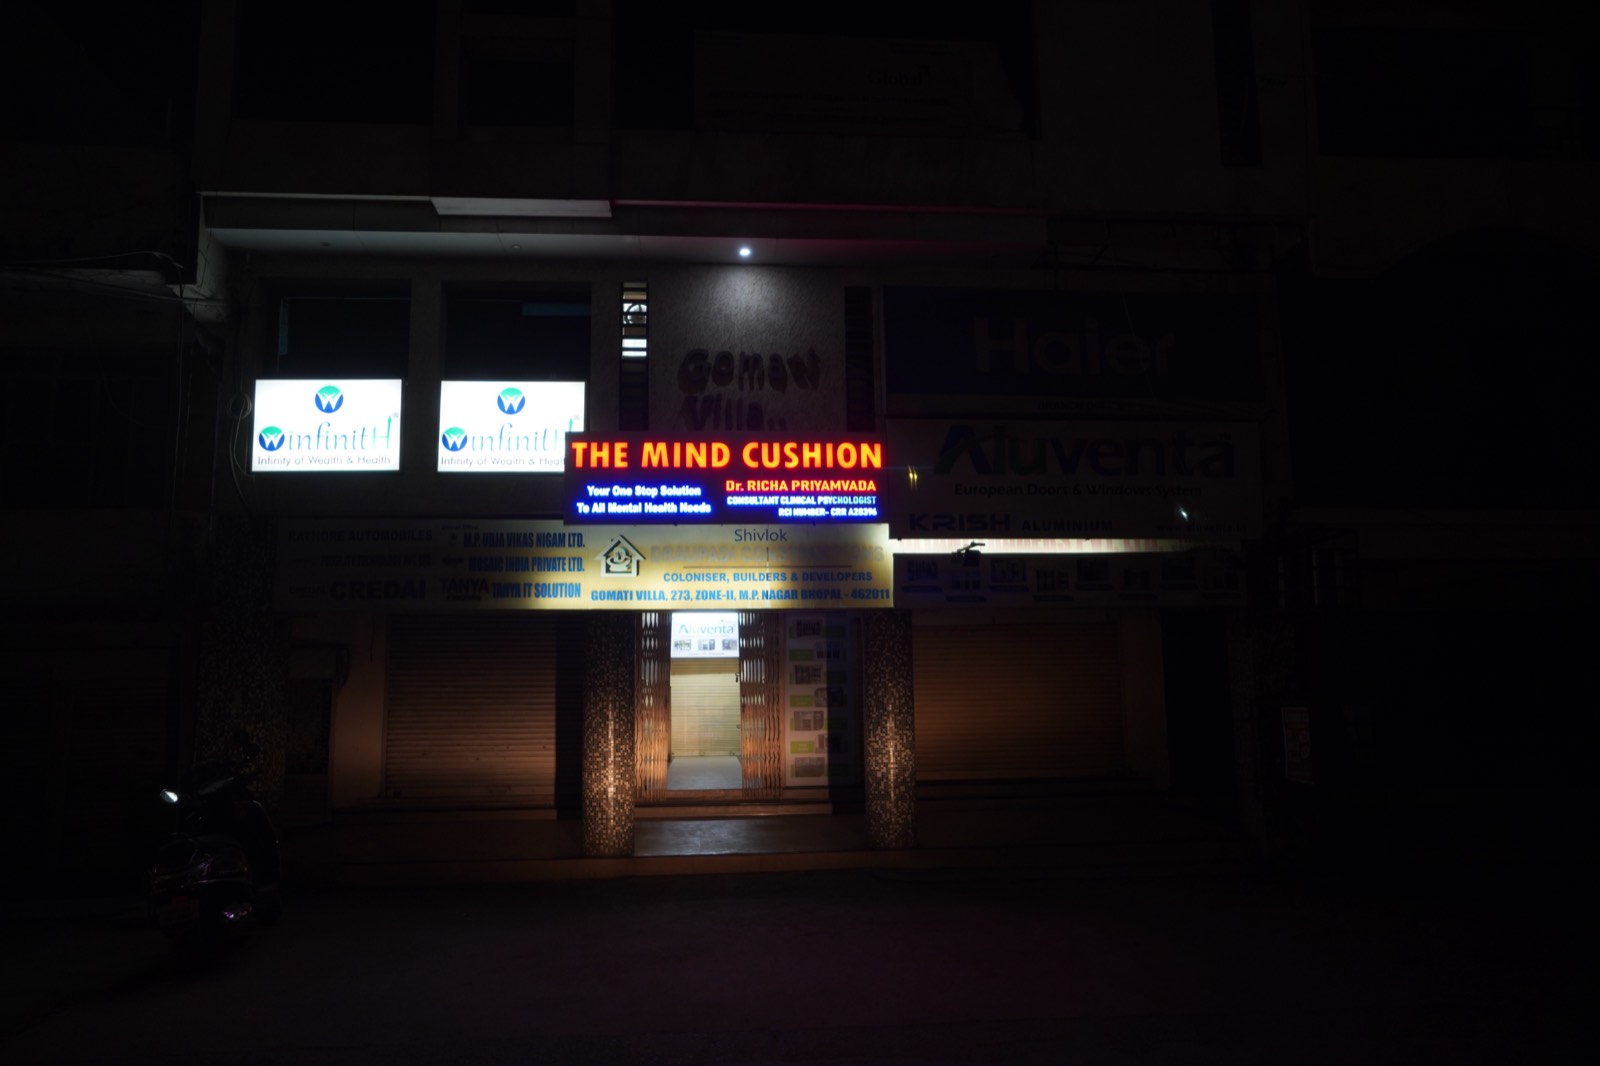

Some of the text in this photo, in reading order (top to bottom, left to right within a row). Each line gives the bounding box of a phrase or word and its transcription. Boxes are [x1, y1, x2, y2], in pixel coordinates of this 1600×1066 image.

[974, 317, 1175, 376] Haier
[572, 442, 882, 468] THE MIND CUSHION
[933, 424, 1235, 478] Aluventa
[258, 455, 390, 467] Infinity of Wealth & Health
[441, 456, 473, 467] Infinity
[477, 457, 487, 465] of
[491, 457, 525, 465] Wealth
[528, 457, 535, 465] &
[587, 485, 702, 498] Your One Stop Solution
[725, 480, 876, 491] Dr. RICHA PRIYAMVADA
[954, 483, 1202, 498] European Doors & Windows System
[727, 496, 876, 505] CONSULTANT CLINICAL PSYCHOLOGIST
[576, 502, 711, 513] To All Mental Health Needs
[778, 508, 792, 516] RCI
[793, 508, 829, 516] NUMBER-
[908, 513, 1113, 532] KRISH ALUMINIUM
[507, 533, 534, 548] VIKAS
[537, 533, 566, 548] NIGAM
[568, 533, 586, 548] LTD.
[734, 529, 788, 542] Shivlok
[506, 557, 530, 571] INDIA
[531, 557, 566, 571] PRIVATE
[568, 557, 585, 571] LTD.
[663, 571, 873, 583] COLONISER, BUILDERS & DEVELOPERS
[330, 580, 427, 600] CREDAI
[440, 578, 489, 593] TANYA
[523, 583, 533, 598] IT
[534, 583, 581, 598] SOLUTION
[591, 590, 633, 601] GOMATI
[636, 590, 668, 602] VILLA,
[670, 590, 693, 602] 273,
[695, 590, 737, 601] ZONE-II,
[739, 590, 760, 601] M.P.
[761, 590, 798, 600] NAGAR
[801, 590, 843, 600] BHOPAL
[850, 589, 890, 599] 462011
